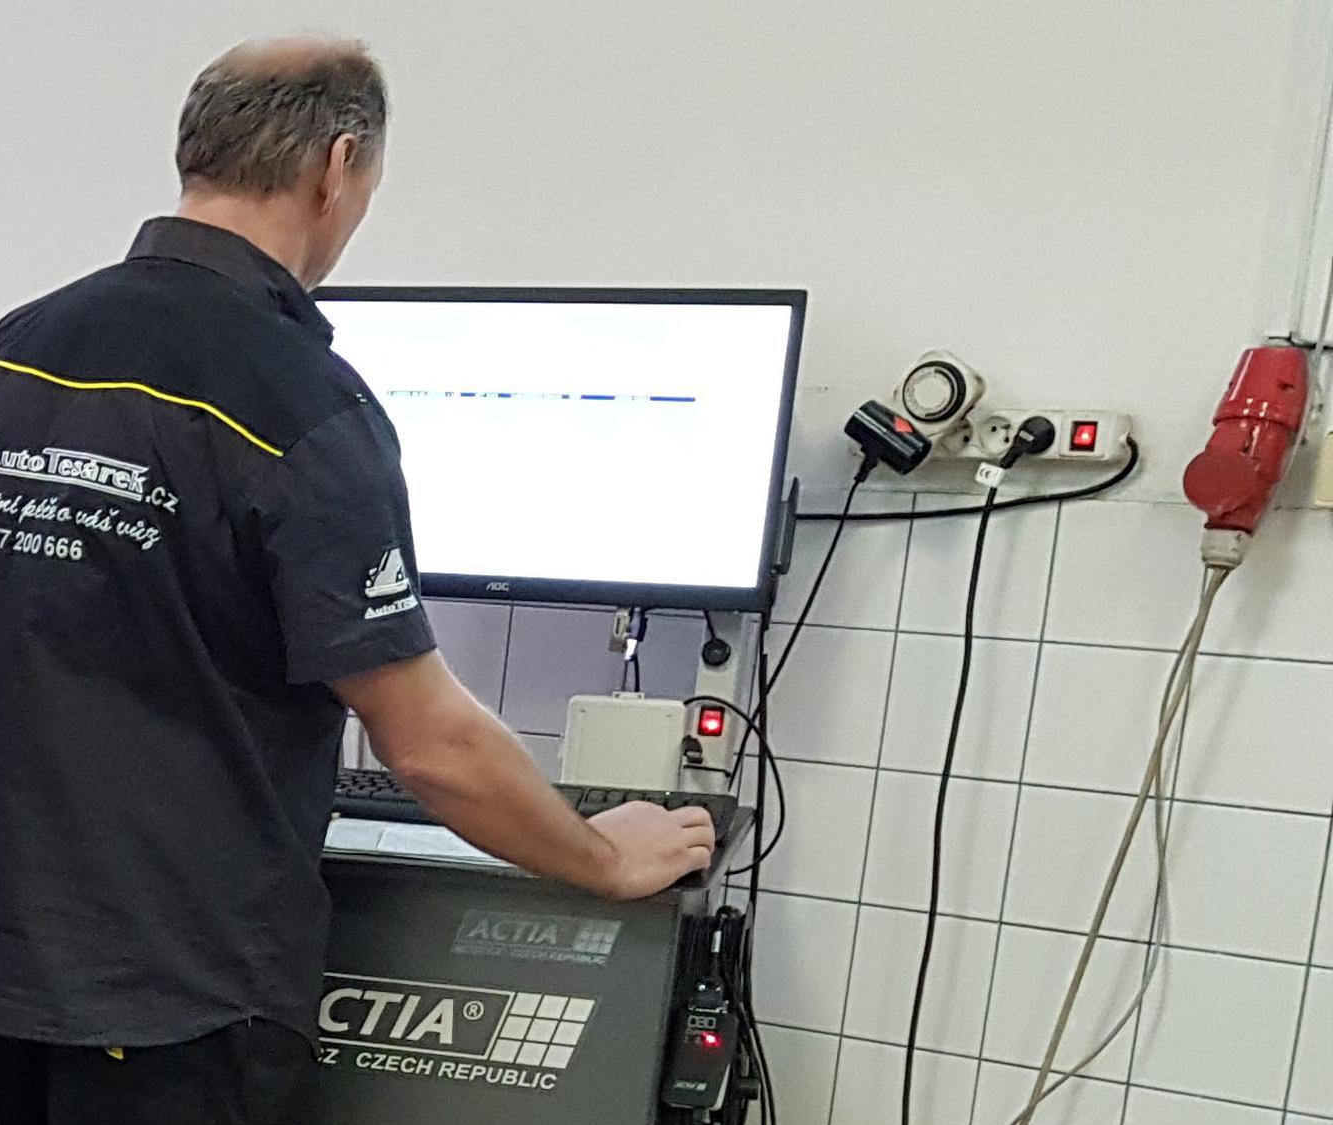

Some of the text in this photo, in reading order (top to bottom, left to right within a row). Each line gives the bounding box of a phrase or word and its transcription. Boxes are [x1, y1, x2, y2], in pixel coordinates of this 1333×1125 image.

[13, 530, 43, 555] 200
[43, 535, 84, 560] 666
[75, 508, 120, 532] váš
[117, 520, 161, 550] vůz
[467, 918, 558, 945] ACTIA
[355, 1051, 434, 1076] CZECH
[437, 1062, 558, 1090] REPUBLIC
